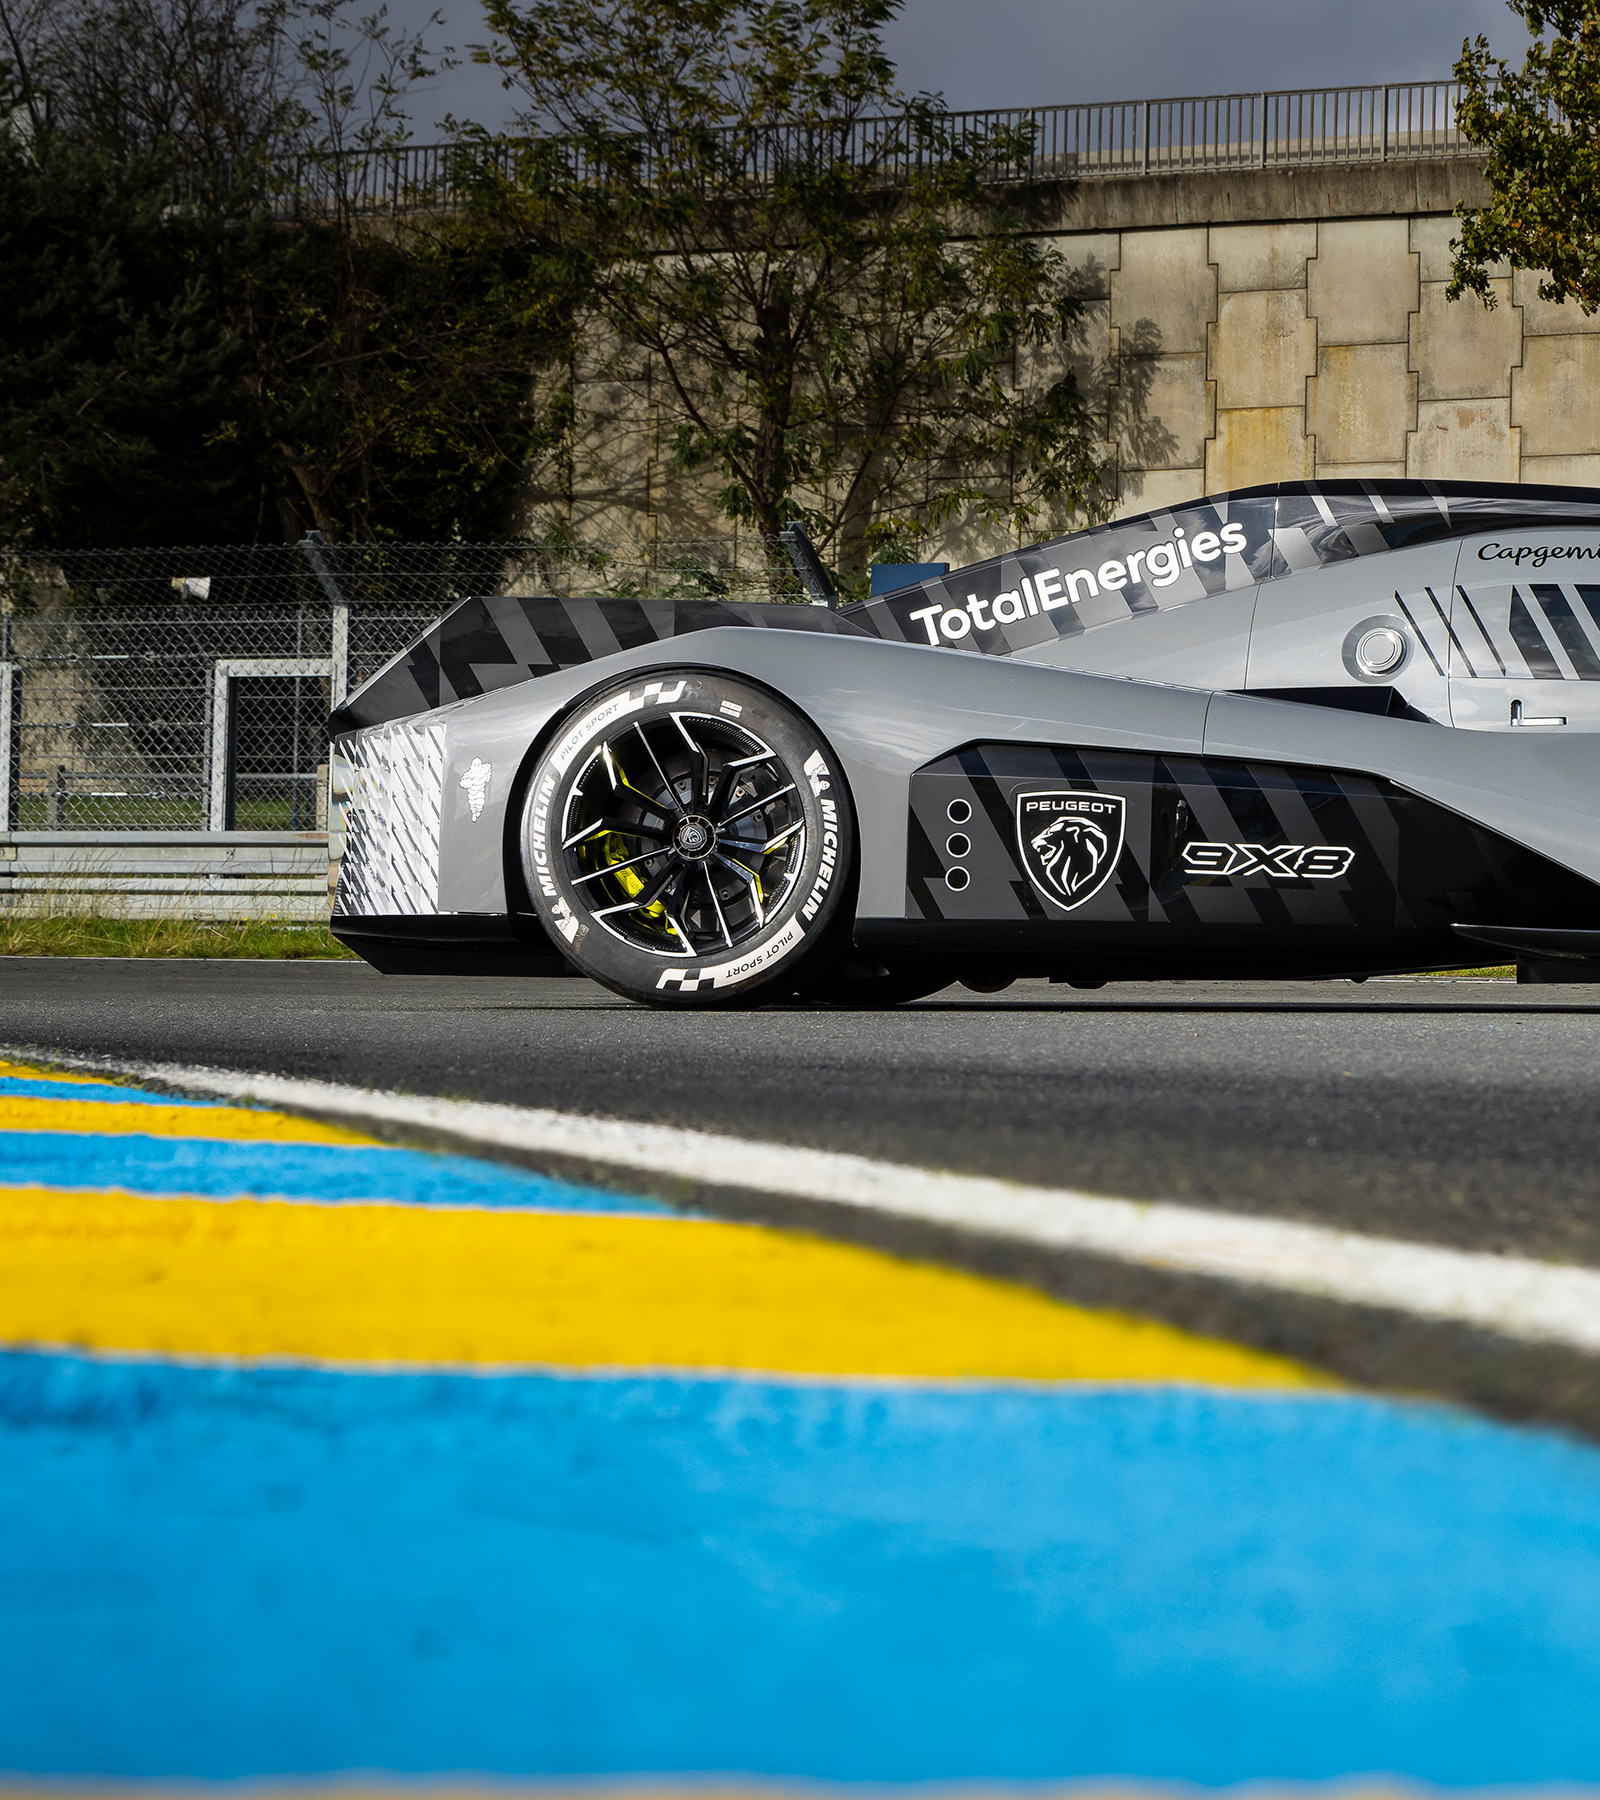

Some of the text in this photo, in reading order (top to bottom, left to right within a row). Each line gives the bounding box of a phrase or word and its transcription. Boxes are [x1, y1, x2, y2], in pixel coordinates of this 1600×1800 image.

[909, 522, 1247, 647] TotalEnergies
[559, 703, 619, 760] PILOT SPORT
[532, 773, 557, 897] MICHELIN
[1026, 800, 1117, 815] PEUGEOT
[801, 798, 838, 921] MICHELIN
[1181, 841, 1356, 879] 9X8
[725, 931, 794, 978] PILOT SPORT
